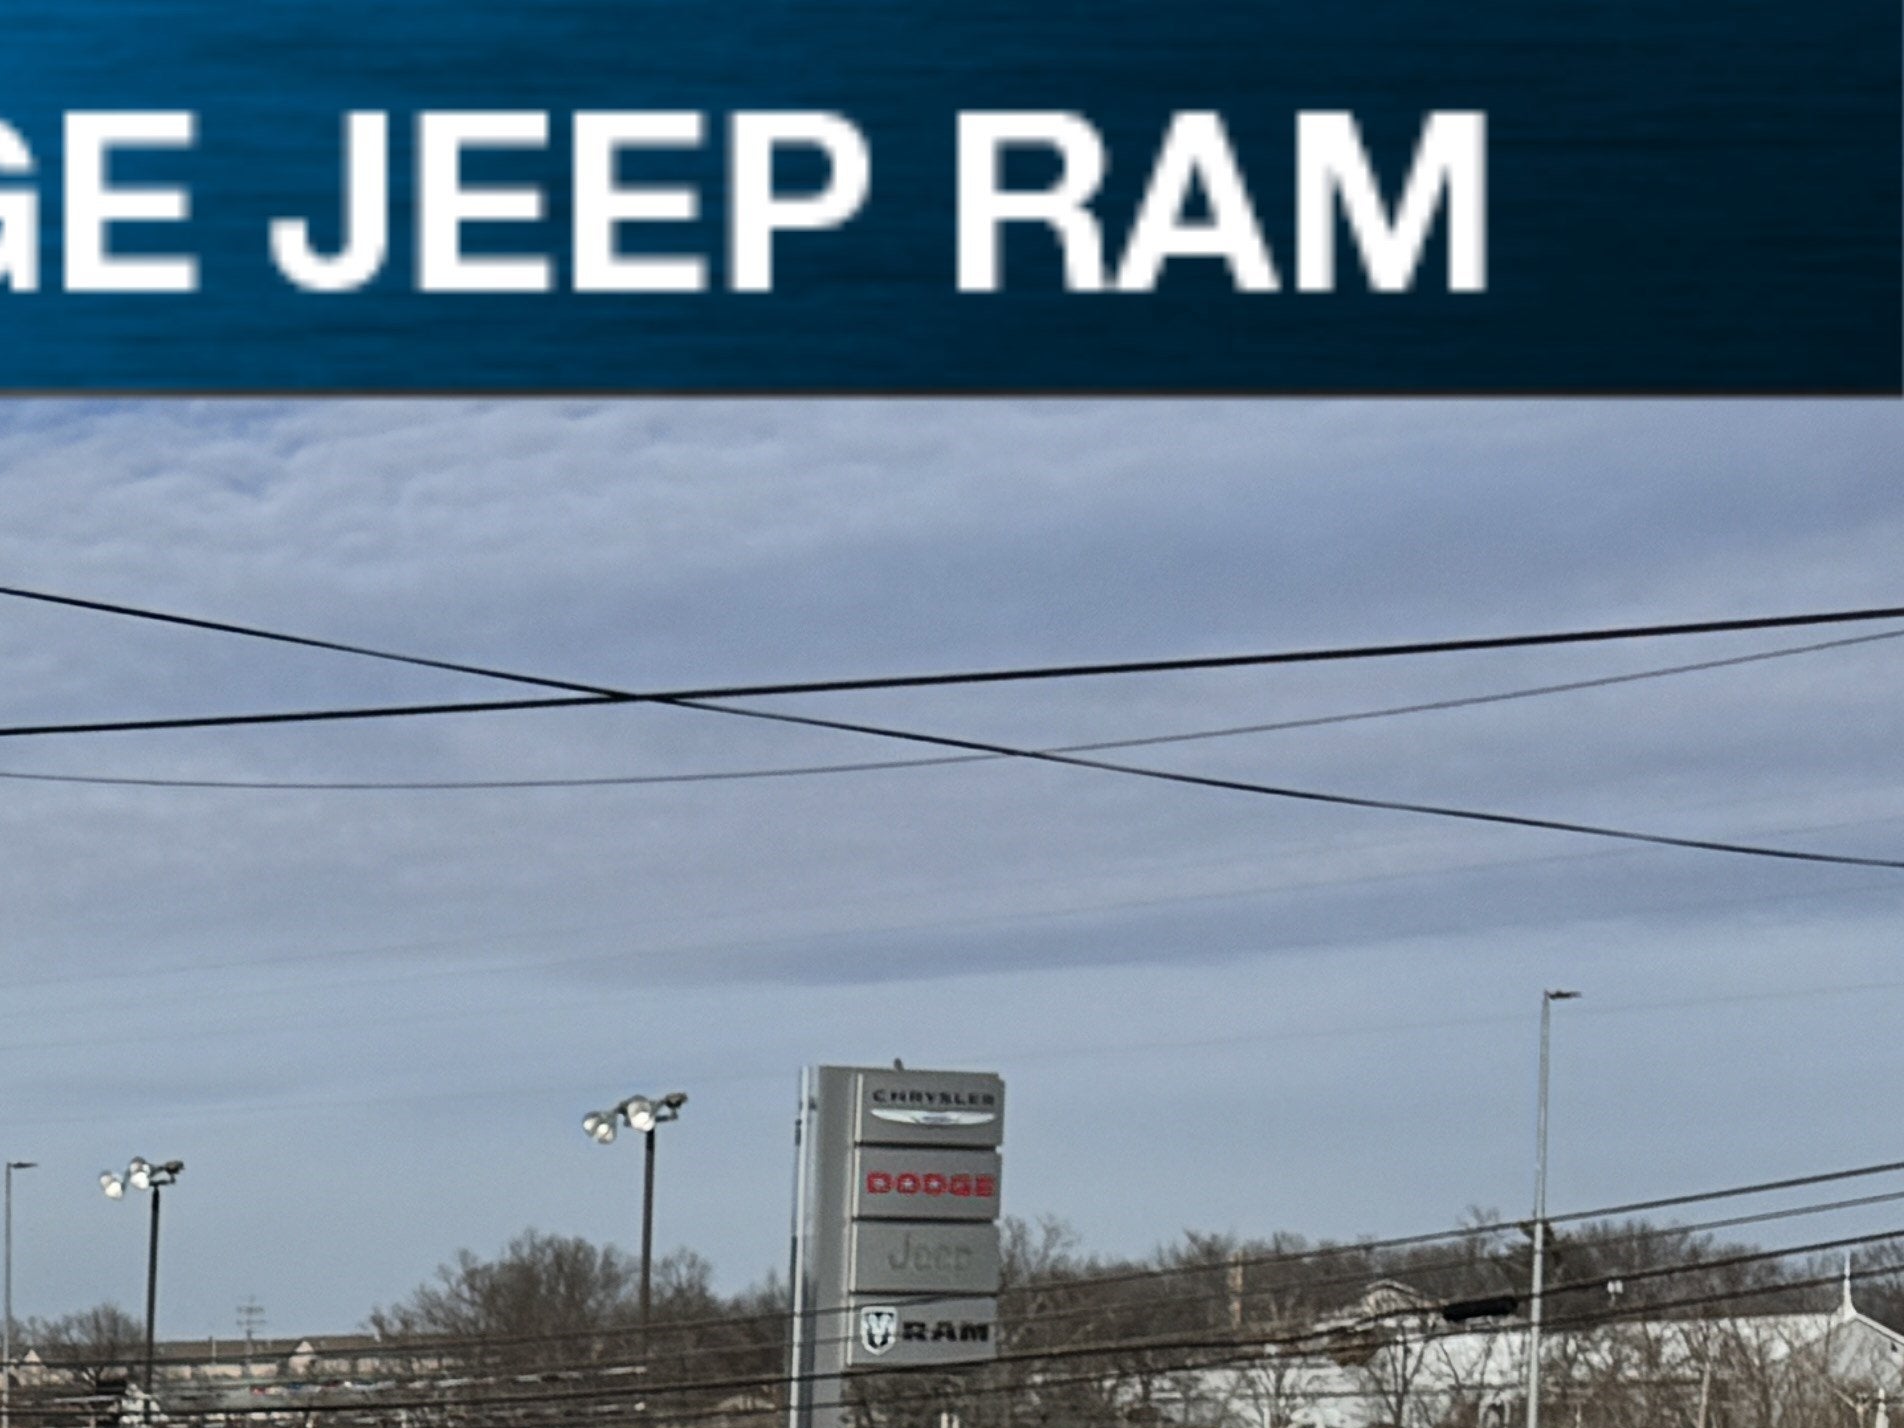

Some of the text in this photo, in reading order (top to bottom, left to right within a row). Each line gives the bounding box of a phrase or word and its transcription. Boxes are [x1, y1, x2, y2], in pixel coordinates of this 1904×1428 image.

[872, 1088, 995, 1107] CHRYSLER
[866, 1171, 996, 1197] DODGE
[902, 1320, 990, 1343] RAM
